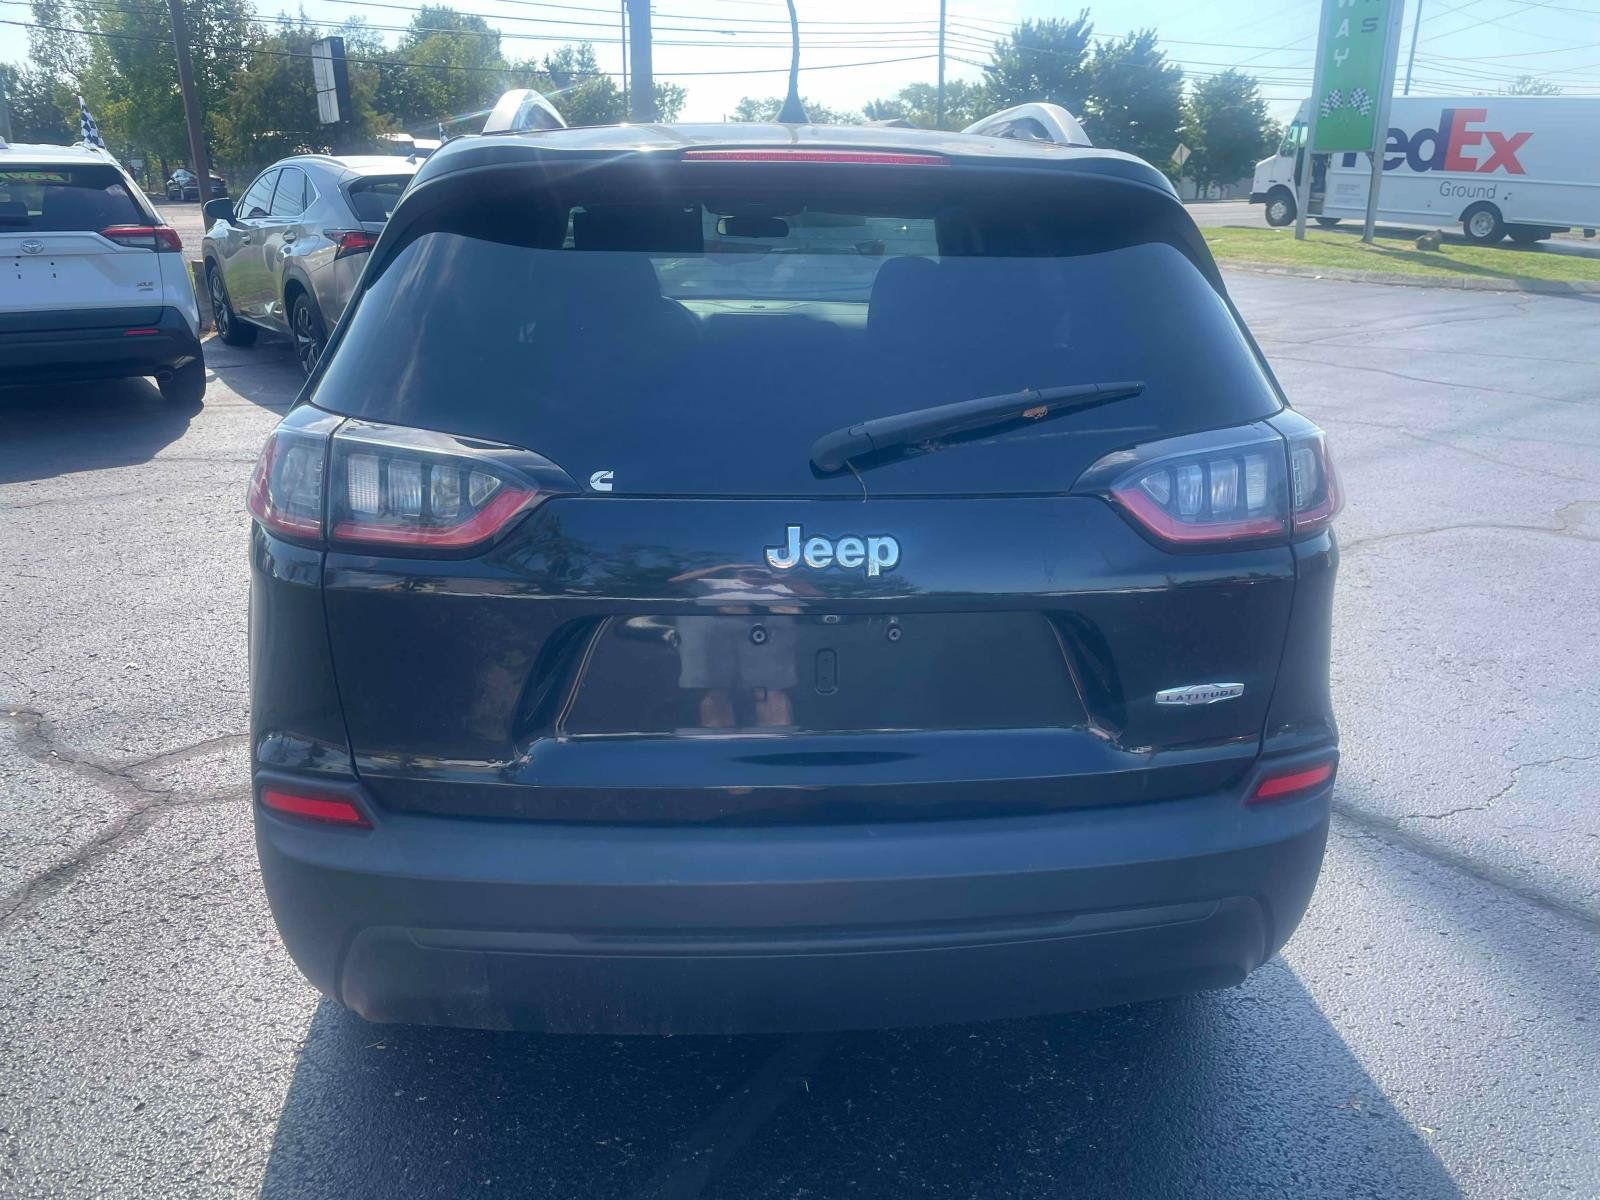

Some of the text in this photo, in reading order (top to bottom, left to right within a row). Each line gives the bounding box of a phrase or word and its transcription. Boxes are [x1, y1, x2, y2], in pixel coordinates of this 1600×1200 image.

[1440, 181, 1497, 199] Ground
[765, 525, 900, 577] Jeep
[1165, 689, 1237, 702] LATITUDE
